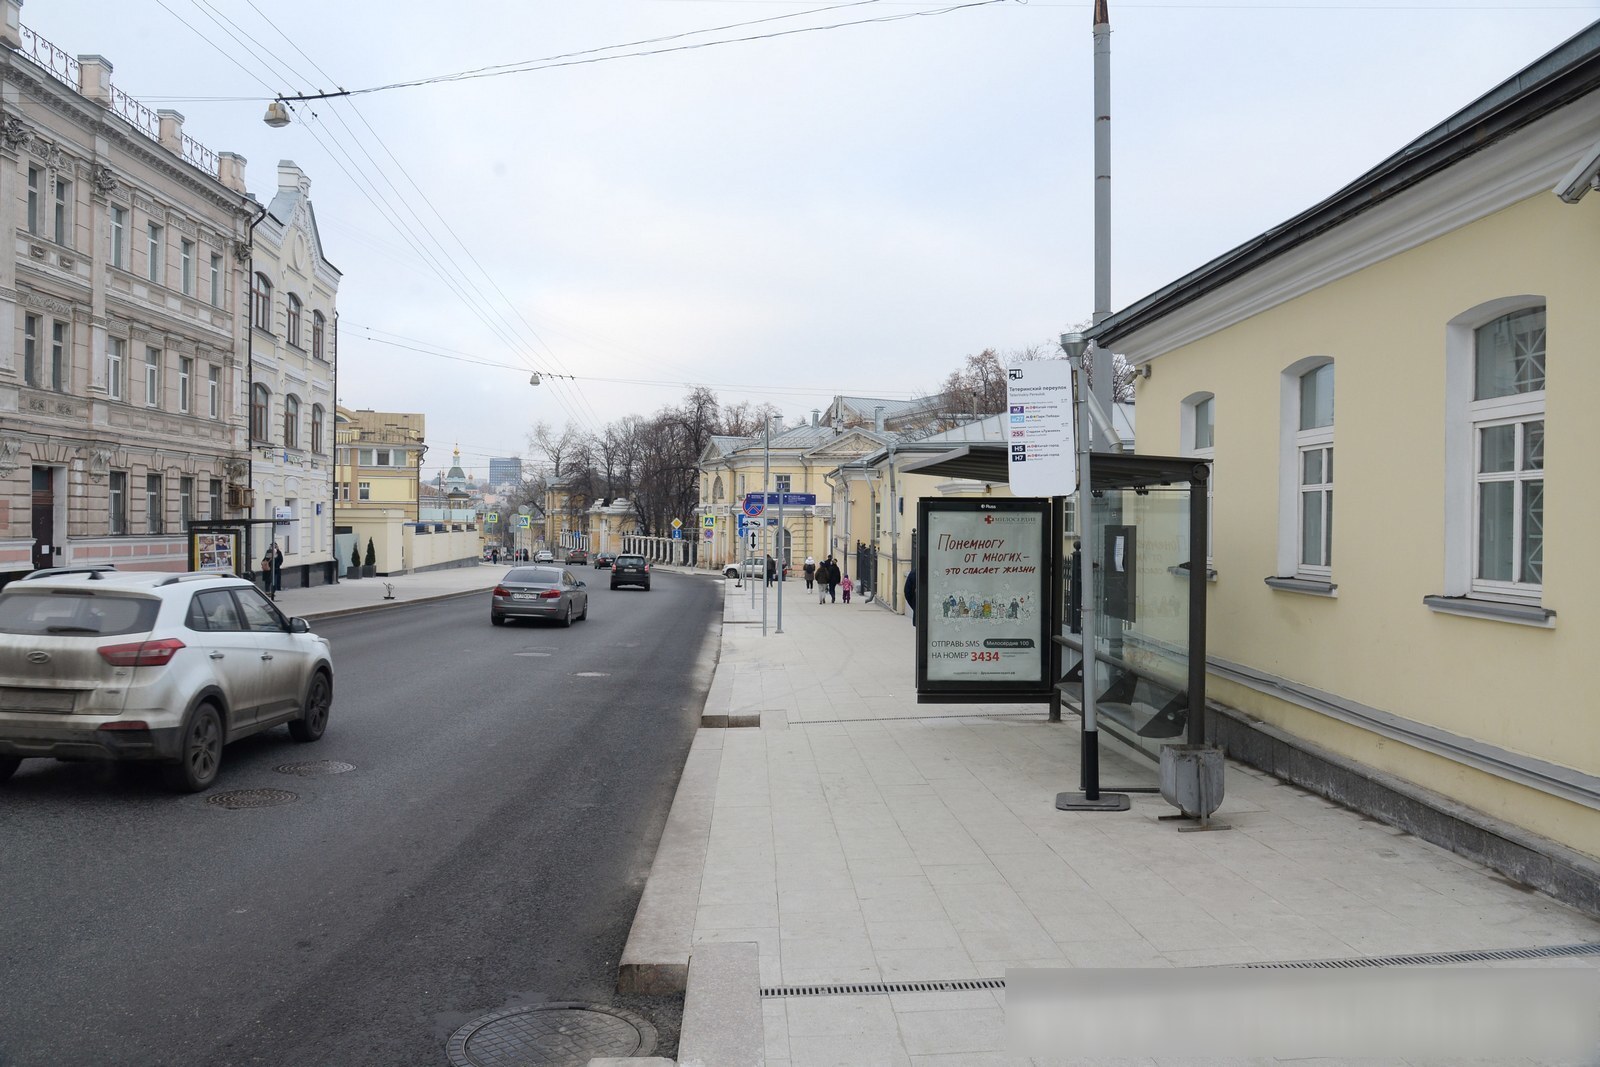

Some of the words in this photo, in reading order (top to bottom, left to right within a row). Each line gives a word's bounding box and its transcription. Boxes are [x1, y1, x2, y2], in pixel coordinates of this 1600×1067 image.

[938, 534, 1005, 551] Понемногу
[1003, 566, 1036, 574] жизни
[970, 651, 1000, 662] 3434
